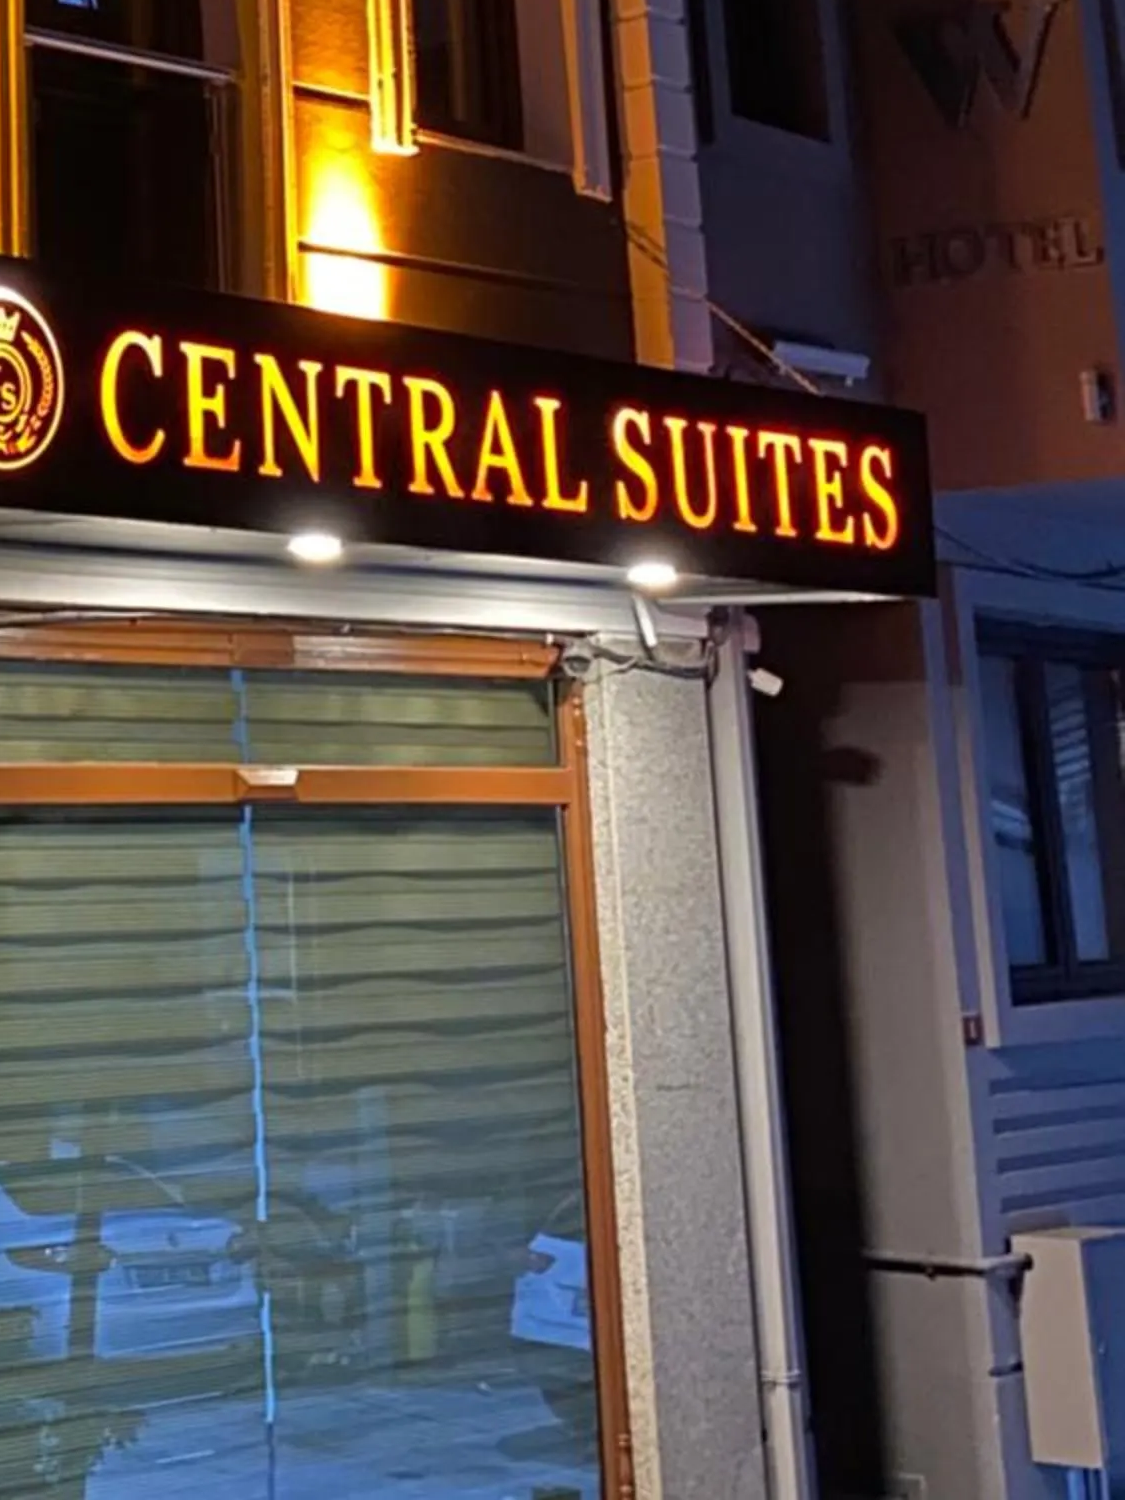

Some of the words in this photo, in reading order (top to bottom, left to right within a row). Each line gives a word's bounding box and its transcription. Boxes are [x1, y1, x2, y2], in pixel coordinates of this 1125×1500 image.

[887, 214, 1105, 288] HOTEL
[99, 329, 588, 514] CENTRAL
[612, 407, 900, 552] SUITES
